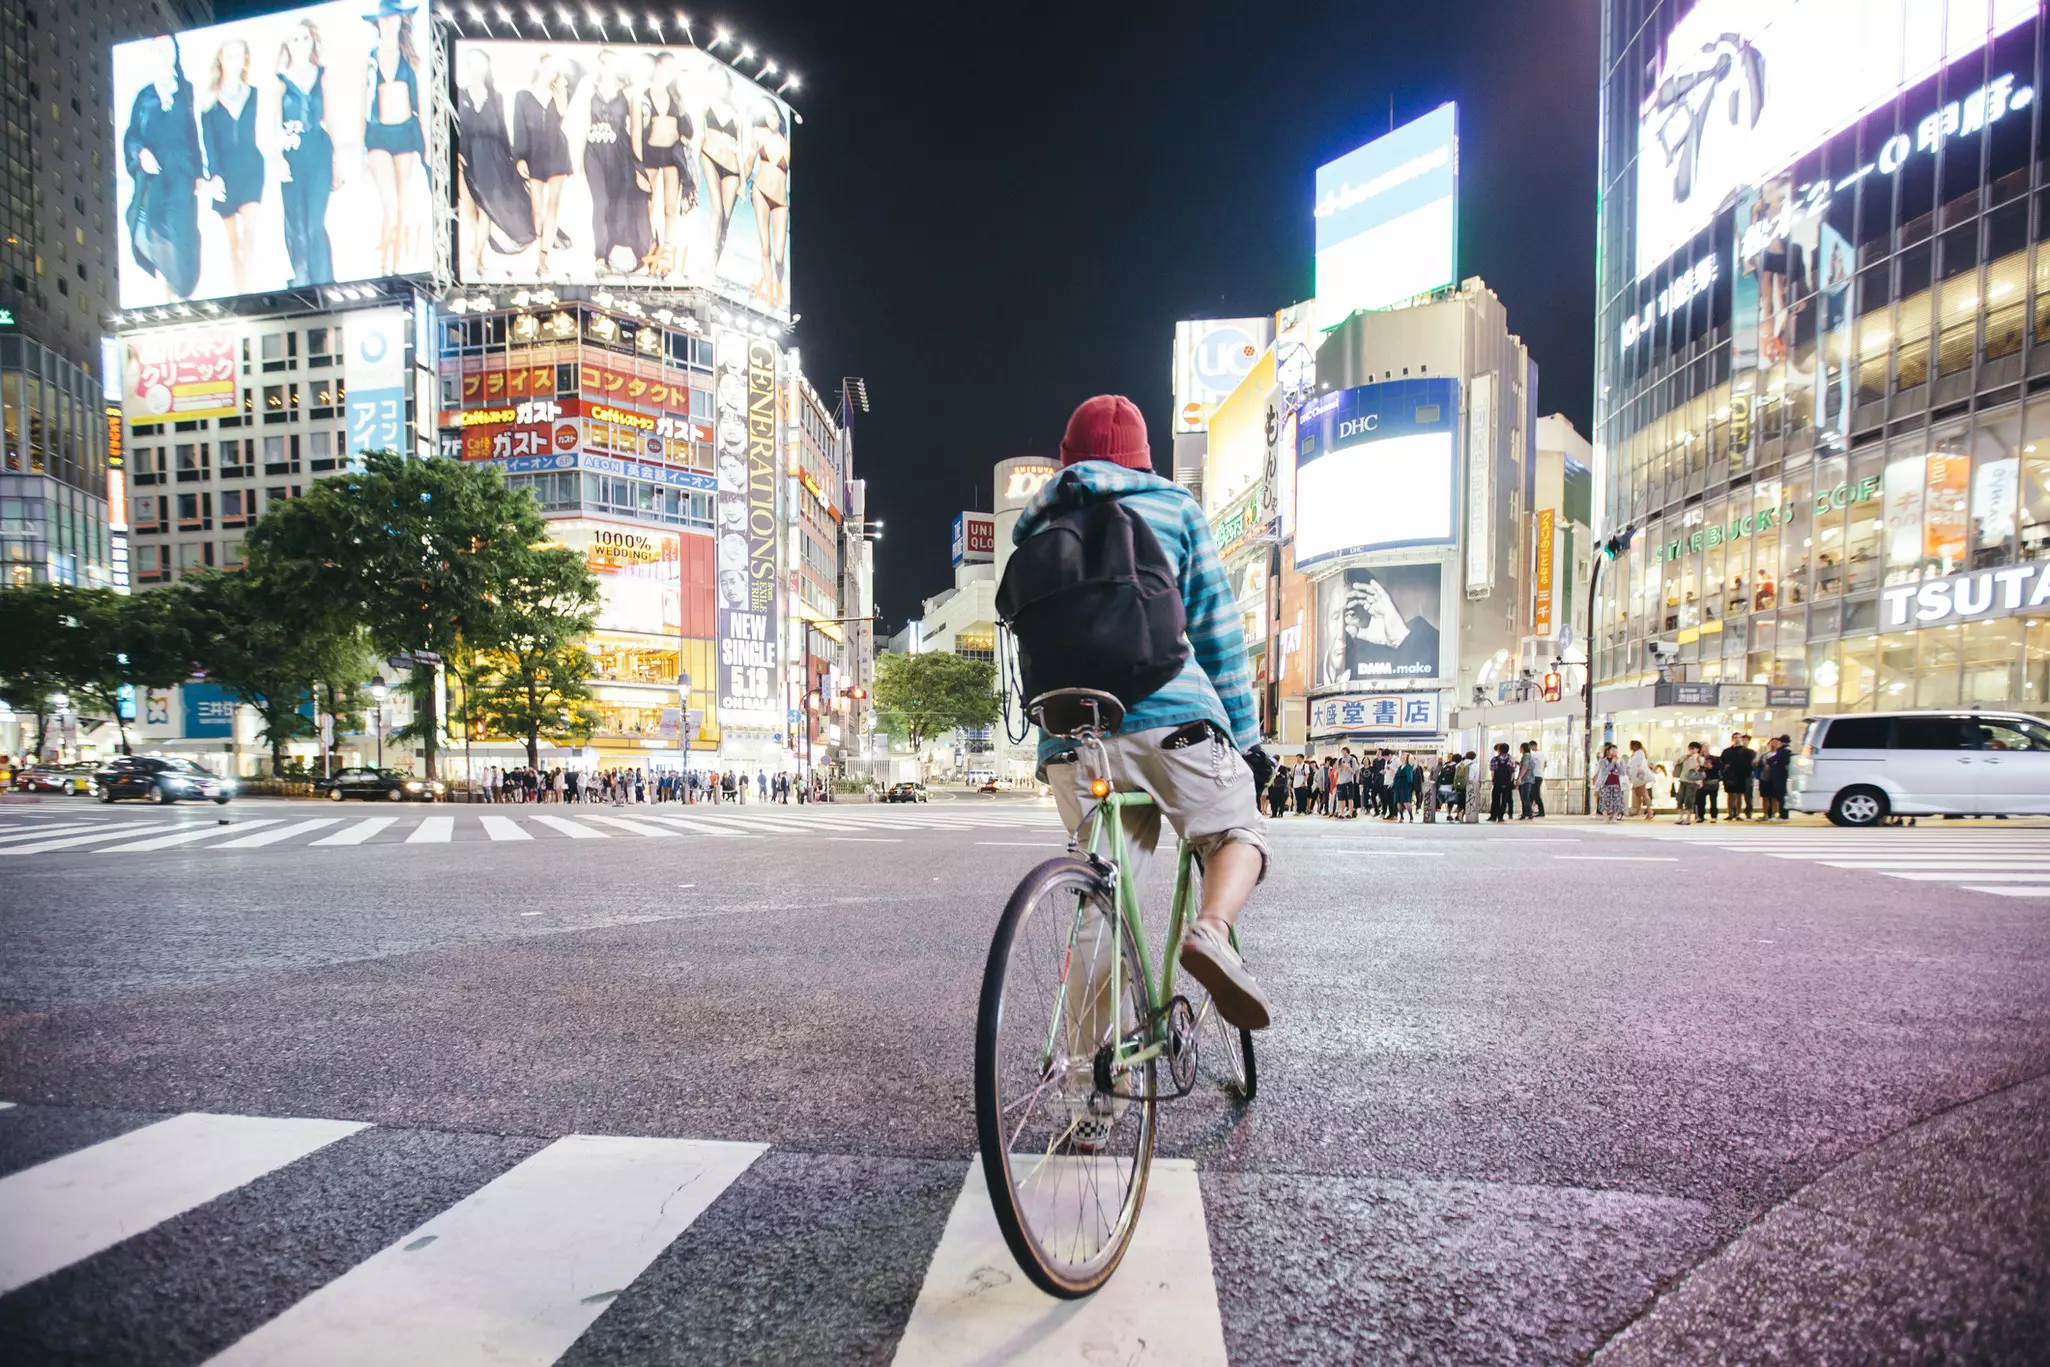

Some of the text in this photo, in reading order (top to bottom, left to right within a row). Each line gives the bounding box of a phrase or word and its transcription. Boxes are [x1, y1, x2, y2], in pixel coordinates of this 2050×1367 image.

[141, 356, 233, 388] クリニック
[581, 367, 687, 407] コンタクト
[516, 400, 563, 425] ガスト
[380, 400, 398, 455] コン
[557, 435, 577, 445] ガスト
[656, 416, 705, 443] ガスト
[1340, 414, 1378, 439] DHC
[442, 440, 462, 457] 7F
[493, 431, 547, 458] ガスト
[584, 455, 621, 473] AEON
[749, 340, 776, 581] GENERATIONS
[1014, 465, 1054, 475] SHIBUYA
[627, 463, 718, 490] 英会話イーオン
[594, 530, 652, 551] 1000%
[970, 524, 994, 536] UNI
[970, 537, 994, 549] QLO
[751, 580, 759, 612] TRIBE
[759, 582, 768, 612] EXILE
[730, 612, 767, 641] NEW
[722, 638, 776, 668] SINGLE
[1358, 661, 1432, 675] DMM.make
[731, 666, 769, 699] 5.13
[1314, 700, 1430, 728] 大盛堂書店
